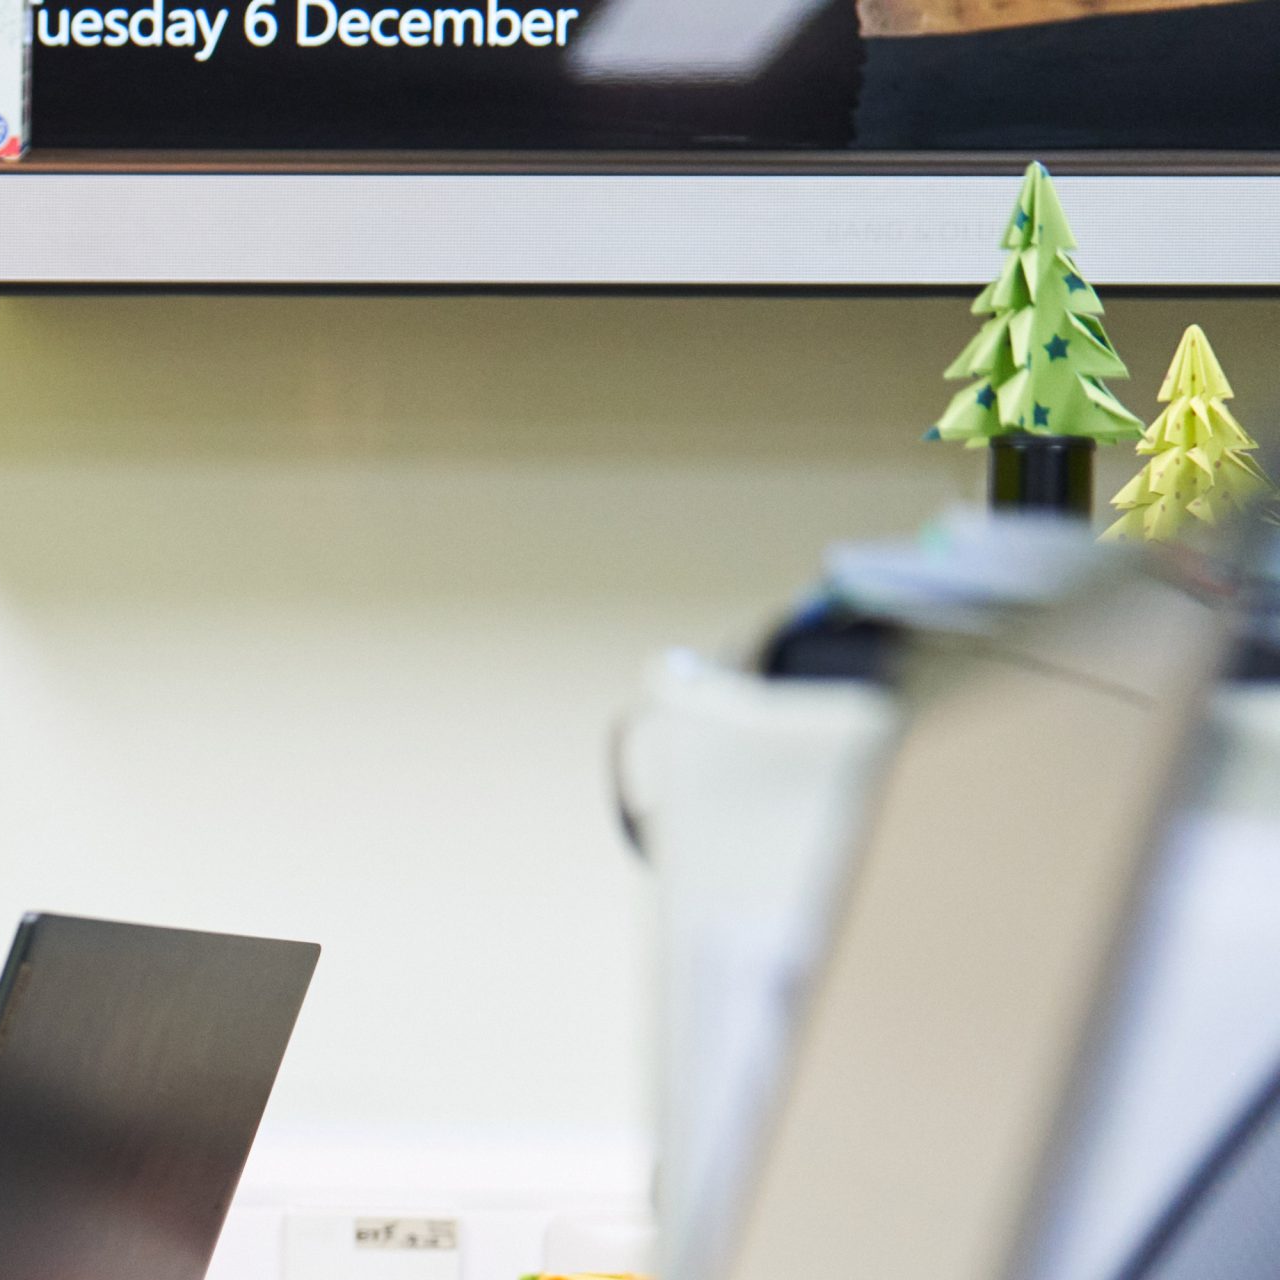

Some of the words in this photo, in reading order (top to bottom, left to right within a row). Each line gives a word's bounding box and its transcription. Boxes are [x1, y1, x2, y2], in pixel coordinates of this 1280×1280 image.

[32, 0, 229, 61] uesday
[244, 0, 279, 47] 6
[296, 0, 579, 47] December
